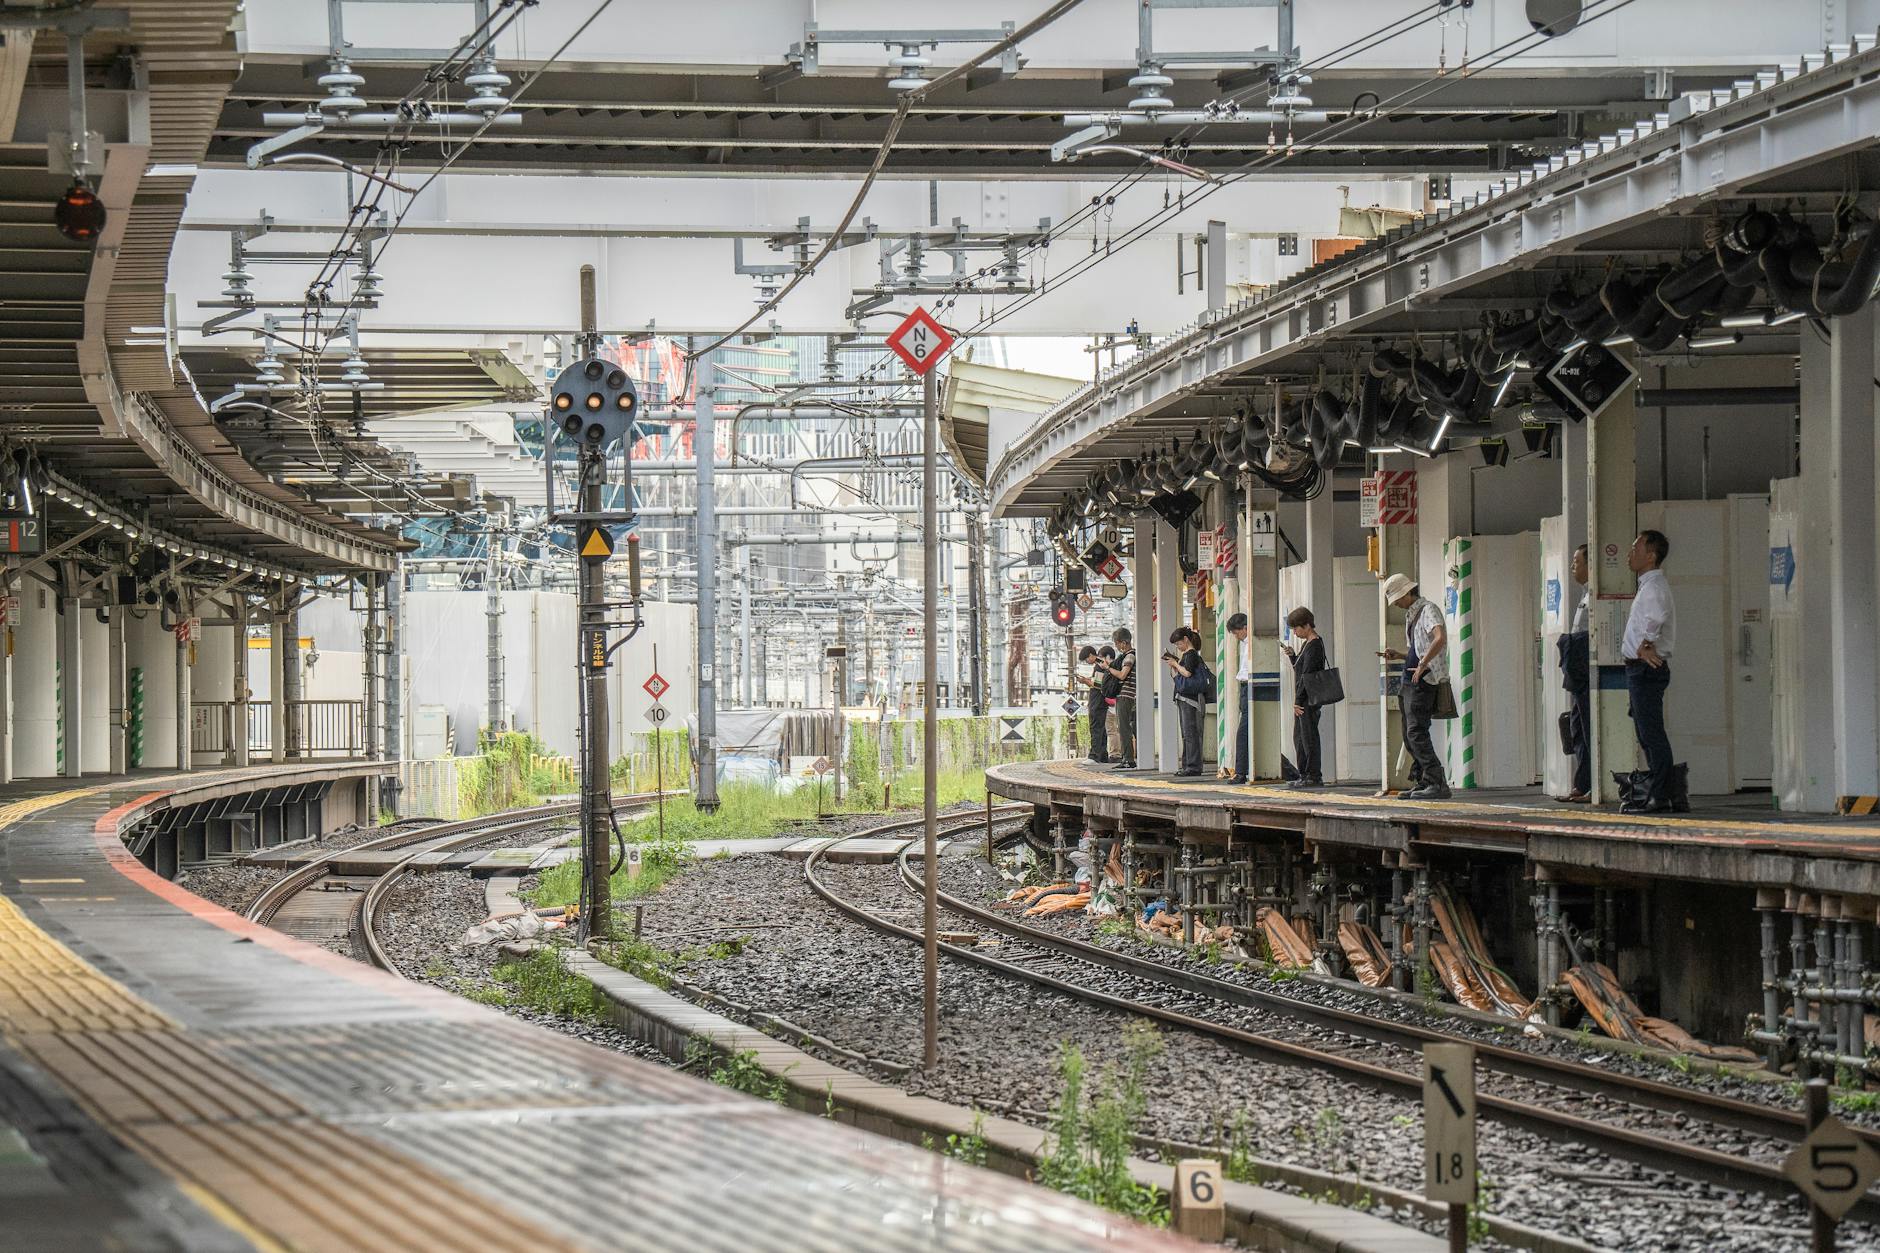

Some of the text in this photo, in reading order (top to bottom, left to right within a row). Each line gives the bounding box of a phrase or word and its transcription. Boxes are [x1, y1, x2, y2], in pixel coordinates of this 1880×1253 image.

[914, 327, 926, 341] N
[914, 343, 926, 358] 6
[20, 520, 37, 537] 12
[1104, 530, 1117, 544] 10
[651, 708, 665, 722] 10
[630, 851, 638, 861] 6
[1436, 1152, 1463, 1184] 1.8
[1811, 1145, 1858, 1192] 5
[1190, 1170, 1214, 1203] 6
